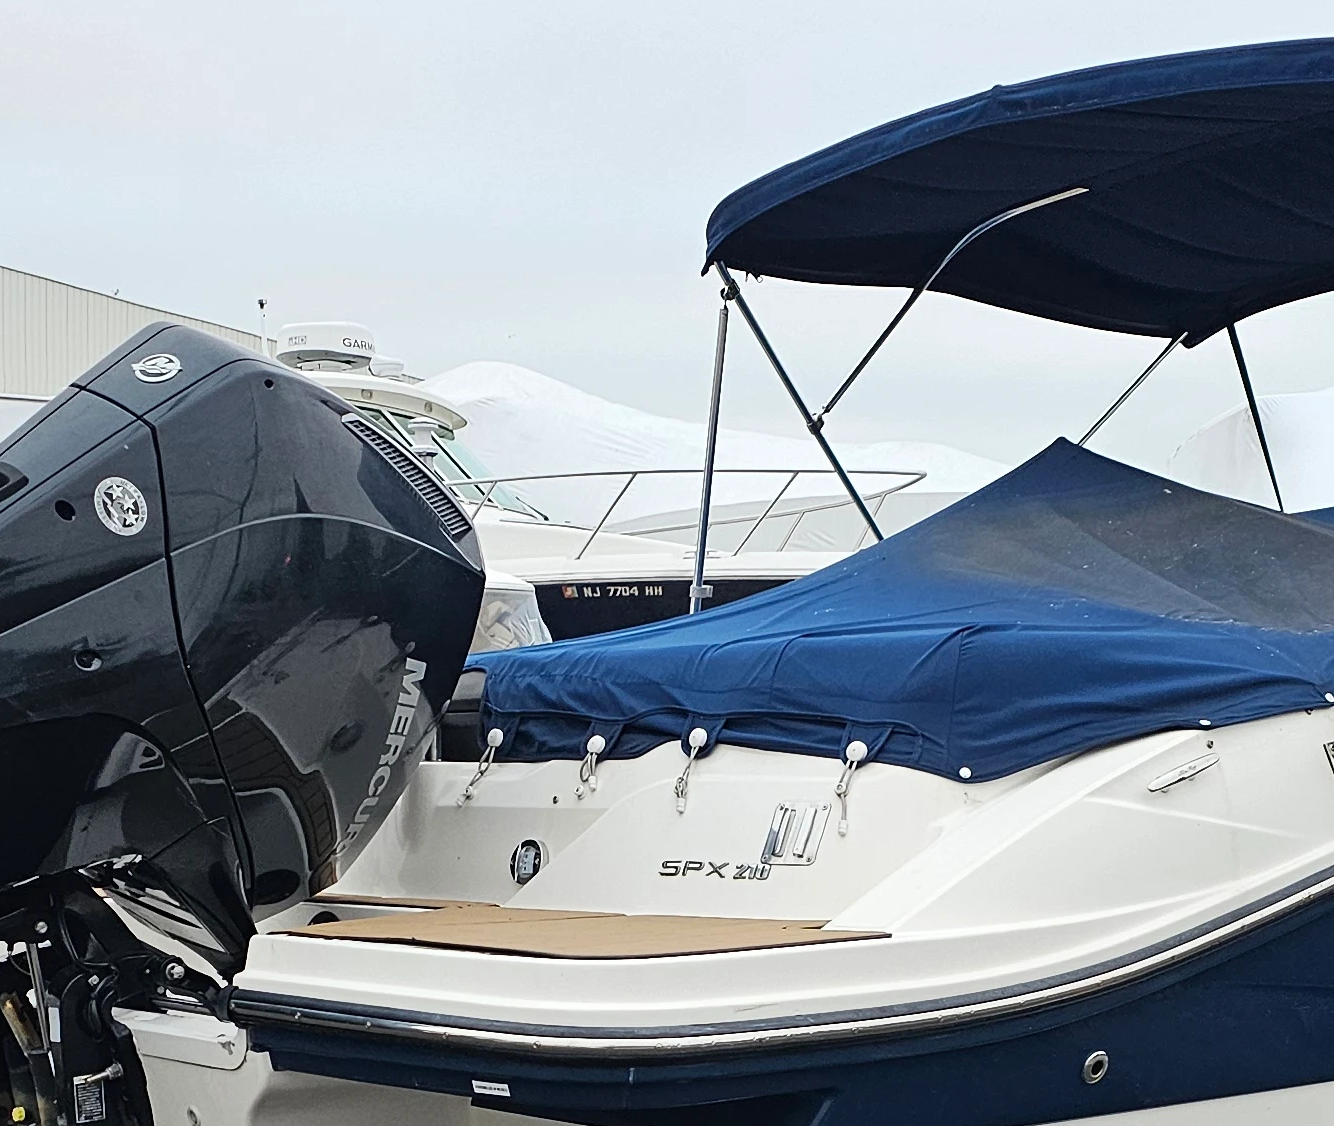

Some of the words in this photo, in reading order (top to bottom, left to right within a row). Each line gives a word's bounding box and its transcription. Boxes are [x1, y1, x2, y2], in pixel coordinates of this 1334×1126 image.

[342, 337, 376, 353] GARM
[583, 586, 601, 598] NJ
[606, 586, 639, 597] 7704
[645, 585, 663, 596] HH
[336, 657, 427, 857] MERCUR
[658, 860, 730, 879] SPX
[732, 864, 771, 880] 210
